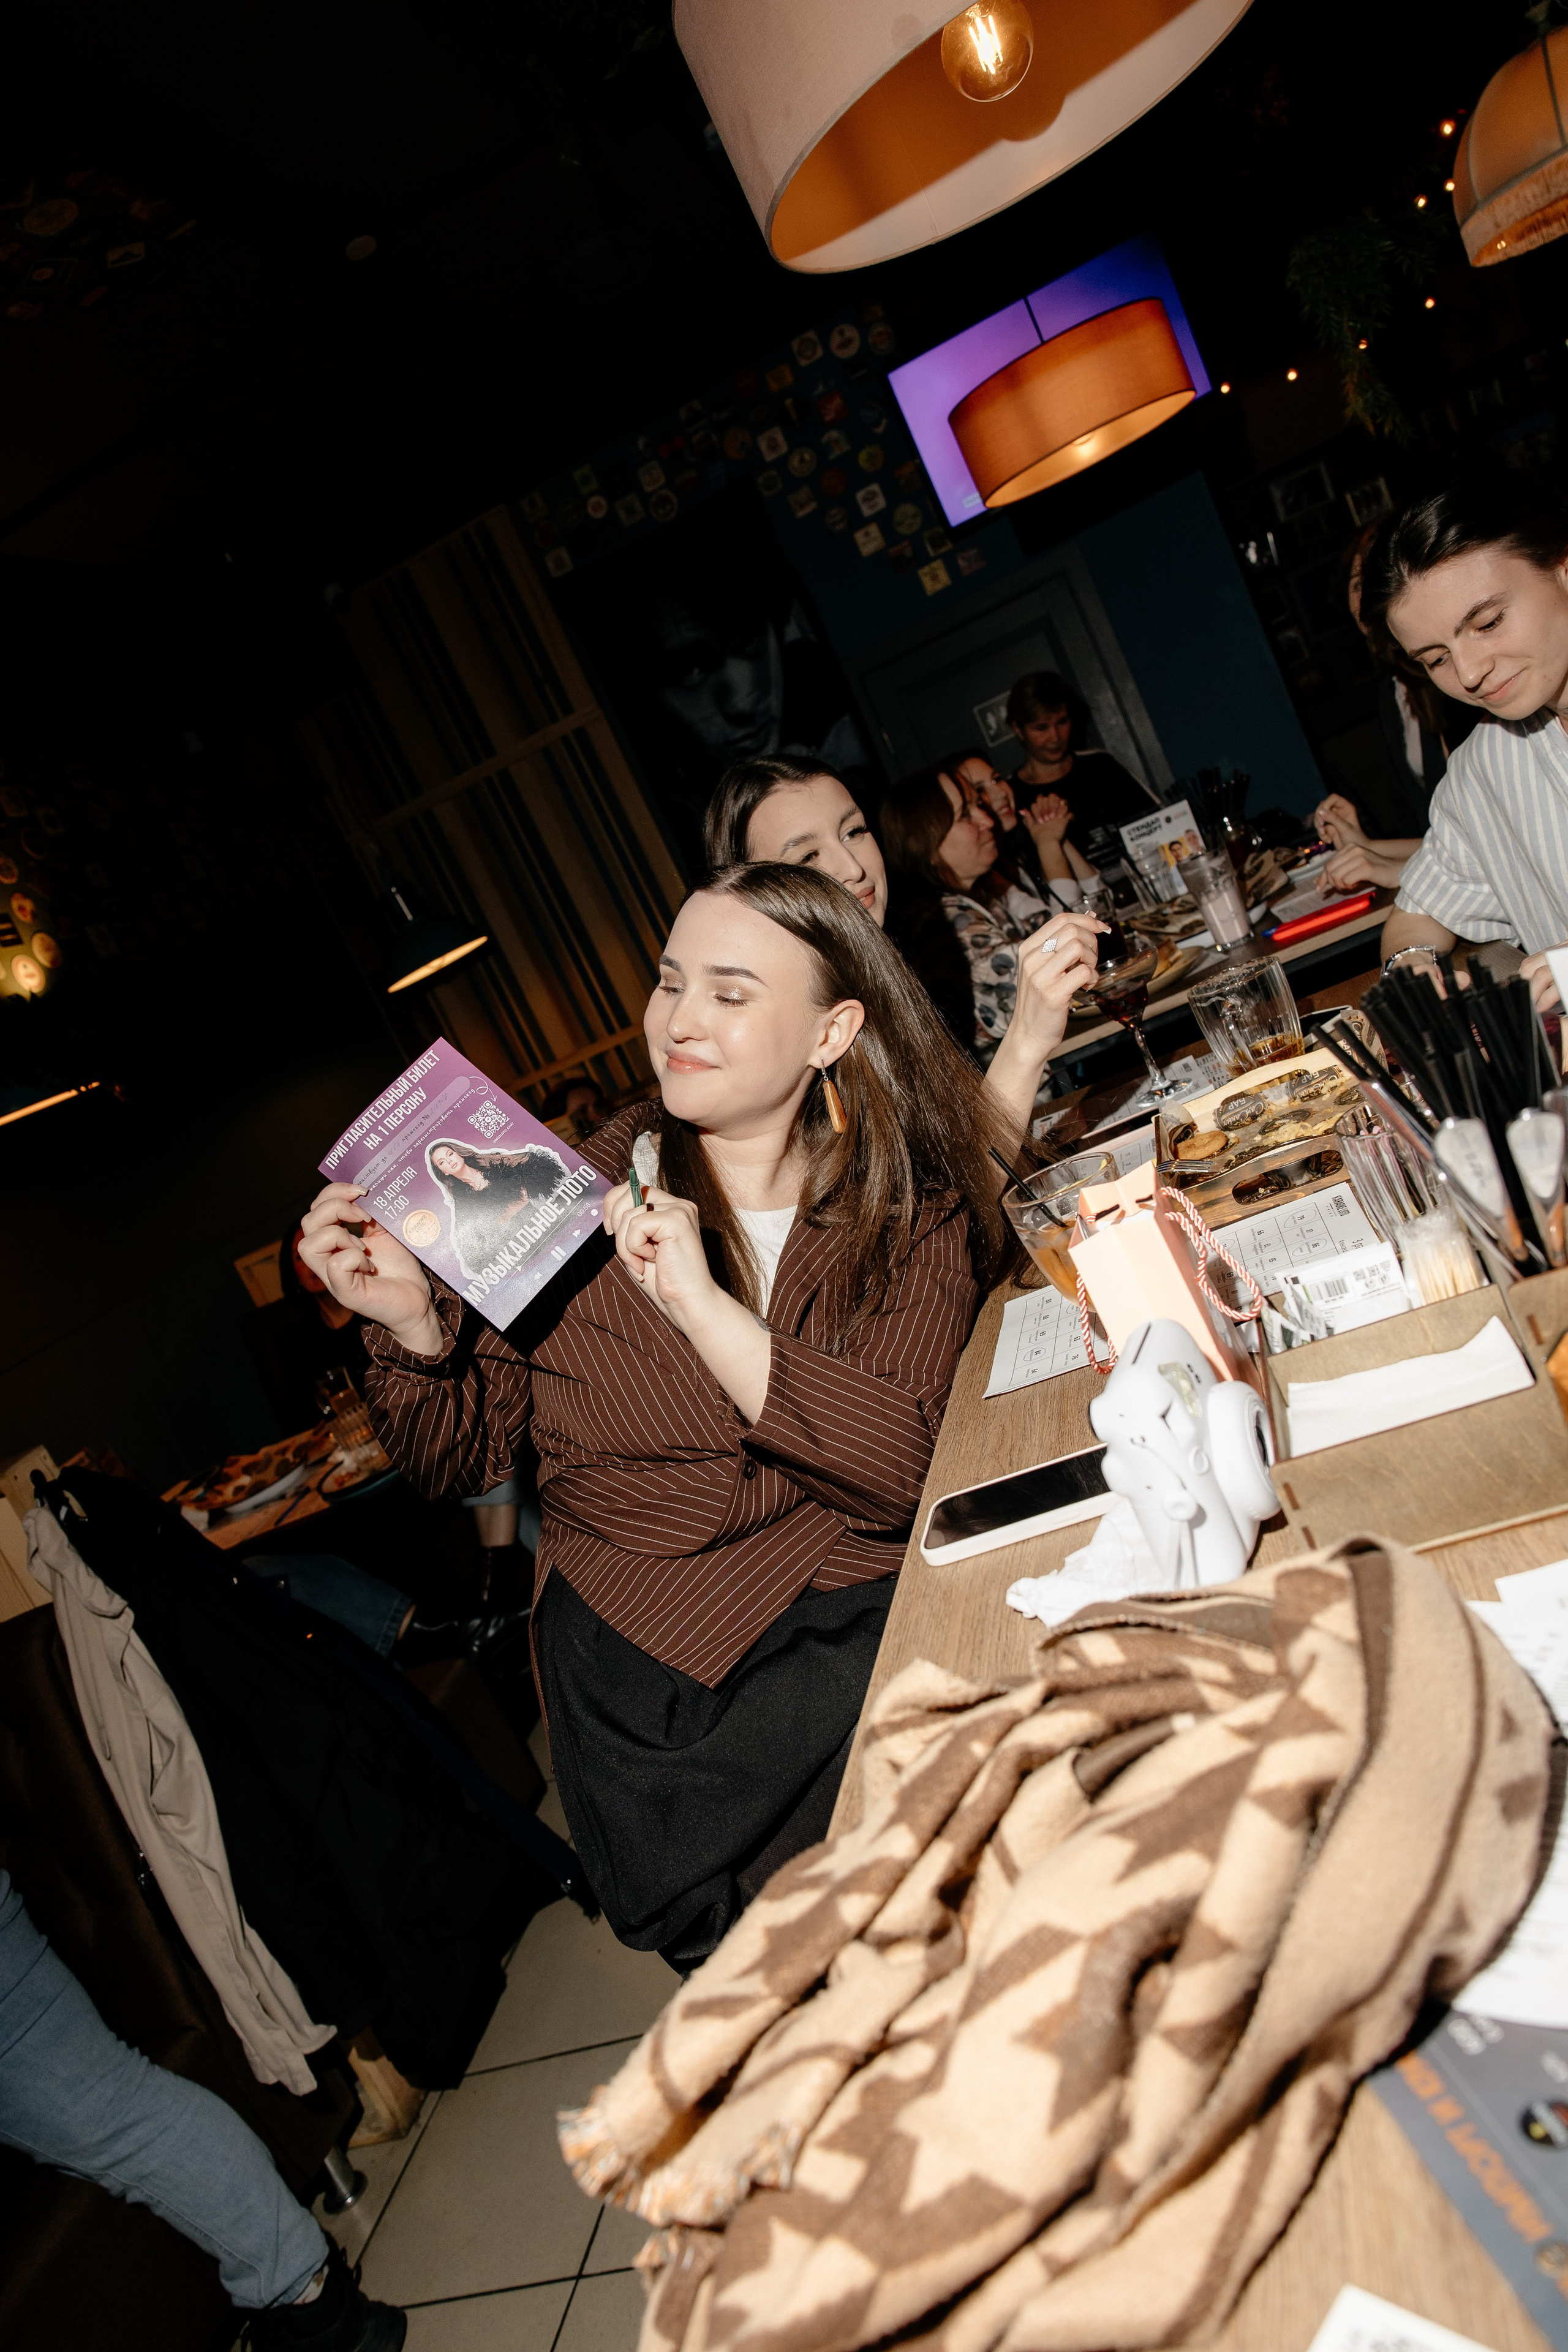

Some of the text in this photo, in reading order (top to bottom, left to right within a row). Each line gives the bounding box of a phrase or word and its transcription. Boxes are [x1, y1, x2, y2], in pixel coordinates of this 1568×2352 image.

[324, 1049, 440, 1170] ПРИГЛАСИТЕЛЬНЫЙ БИЛЕТ
[362, 1086, 427, 1151] НА 1 ПЕРСОНУ
[1227, 1097, 1246, 1110] БАР
[368, 1172, 387, 1191] напиши
[386, 1162, 399, 1174] нам,
[412, 1109, 453, 1148] зарегистрировать
[452, 1087, 475, 1110] промокод
[401, 1120, 424, 1143] промокод
[372, 1165, 418, 1210] 18 АПРЕЛЯ
[383, 1194, 410, 1220] 17:00
[1331, 1194, 1346, 1212] KARAOKE
[462, 1163, 598, 1306] МУЗЫКАЛЬНОЕ ЛОТО
